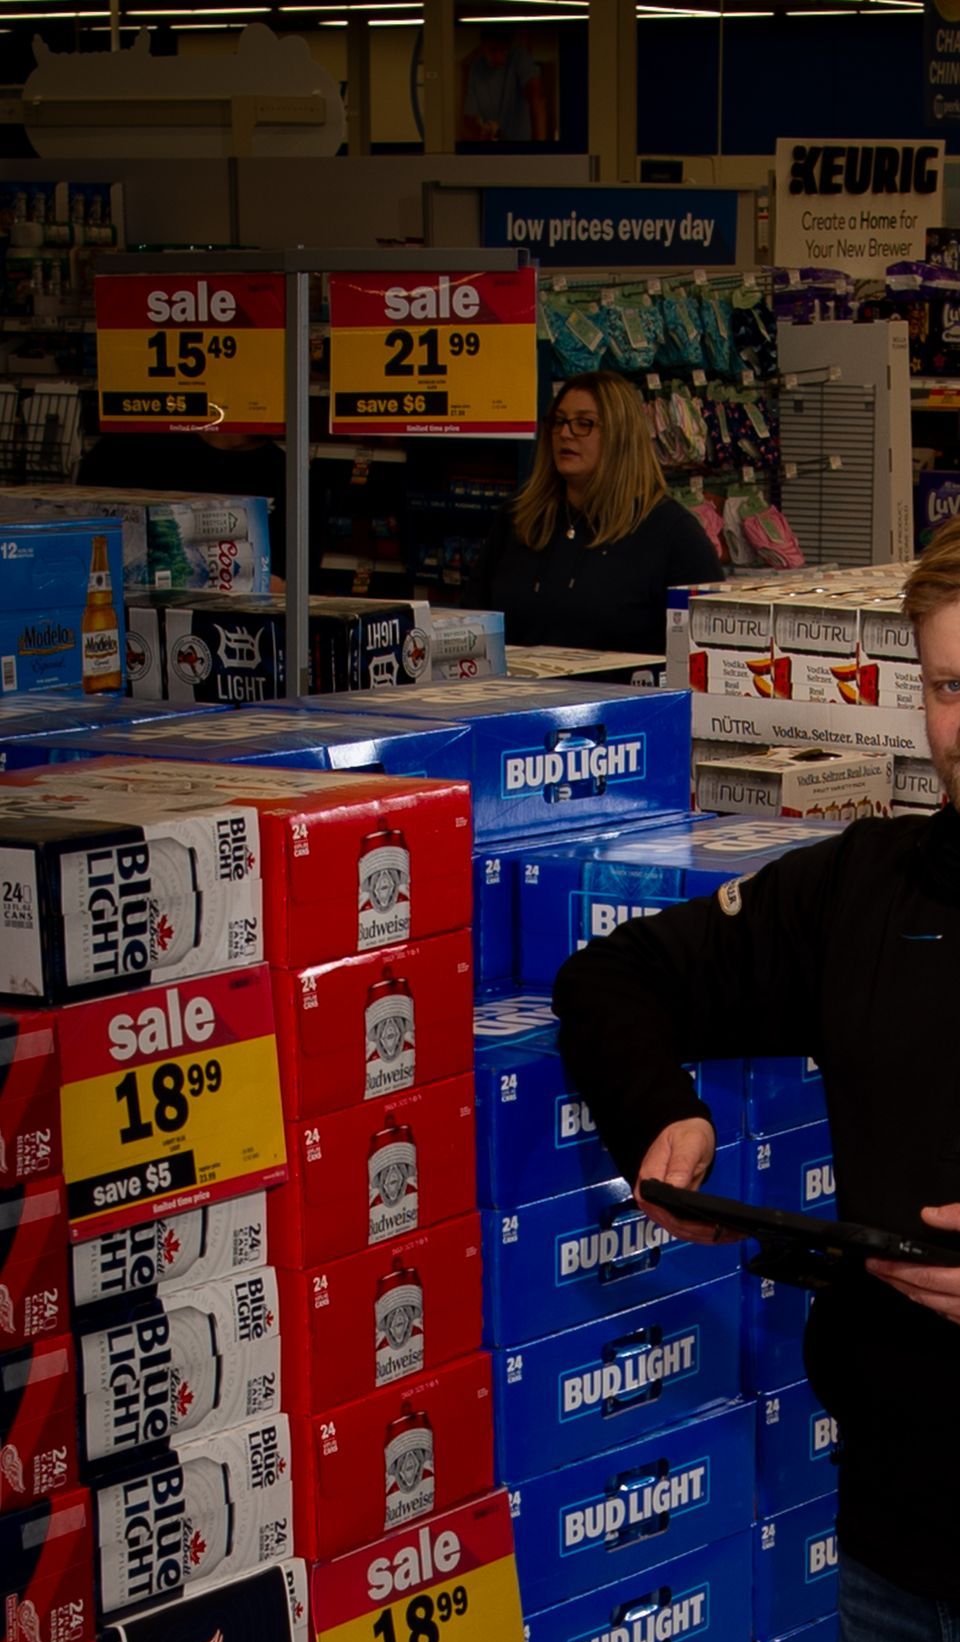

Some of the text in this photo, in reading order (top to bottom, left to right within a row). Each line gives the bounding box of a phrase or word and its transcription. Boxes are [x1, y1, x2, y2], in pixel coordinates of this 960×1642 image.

[790, 146, 937, 194] KEURIG
[507, 211, 715, 246] low prices every day
[802, 210, 918, 231] Create a Home for
[806, 240, 912, 258] Your New Brewer
[147, 281, 236, 322] sale
[384, 276, 480, 320] sale
[122, 395, 187, 414] save $5
[356, 394, 426, 414] save $6
[0, 542, 17, 559] 12
[219, 540, 240, 593] Coor
[24, 623, 70, 648] Modelo
[217, 674, 267, 701] LIGHT
[811, 727, 854, 745] Seltzer.
[856, 732, 881, 747] Real
[883, 734, 917, 750] Juice.
[507, 743, 642, 790] BUD LIGHT
[217, 820, 232, 881] LIGHT
[229, 817, 246, 880] Blue
[3, 882, 23, 903] 24
[86, 851, 119, 975] LIGHT
[115, 842, 151, 974] Blue
[4, 911, 33, 921] CANS
[108, 989, 216, 1061] sale
[501, 1073, 517, 1089] 24
[93, 1161, 172, 1208] save $5
[563, 1335, 696, 1413] BUD LIGHT
[122, 1476, 153, 1598] LIGHT
[151, 1459, 186, 1591] Blue
[367, 1527, 461, 1600] sale
